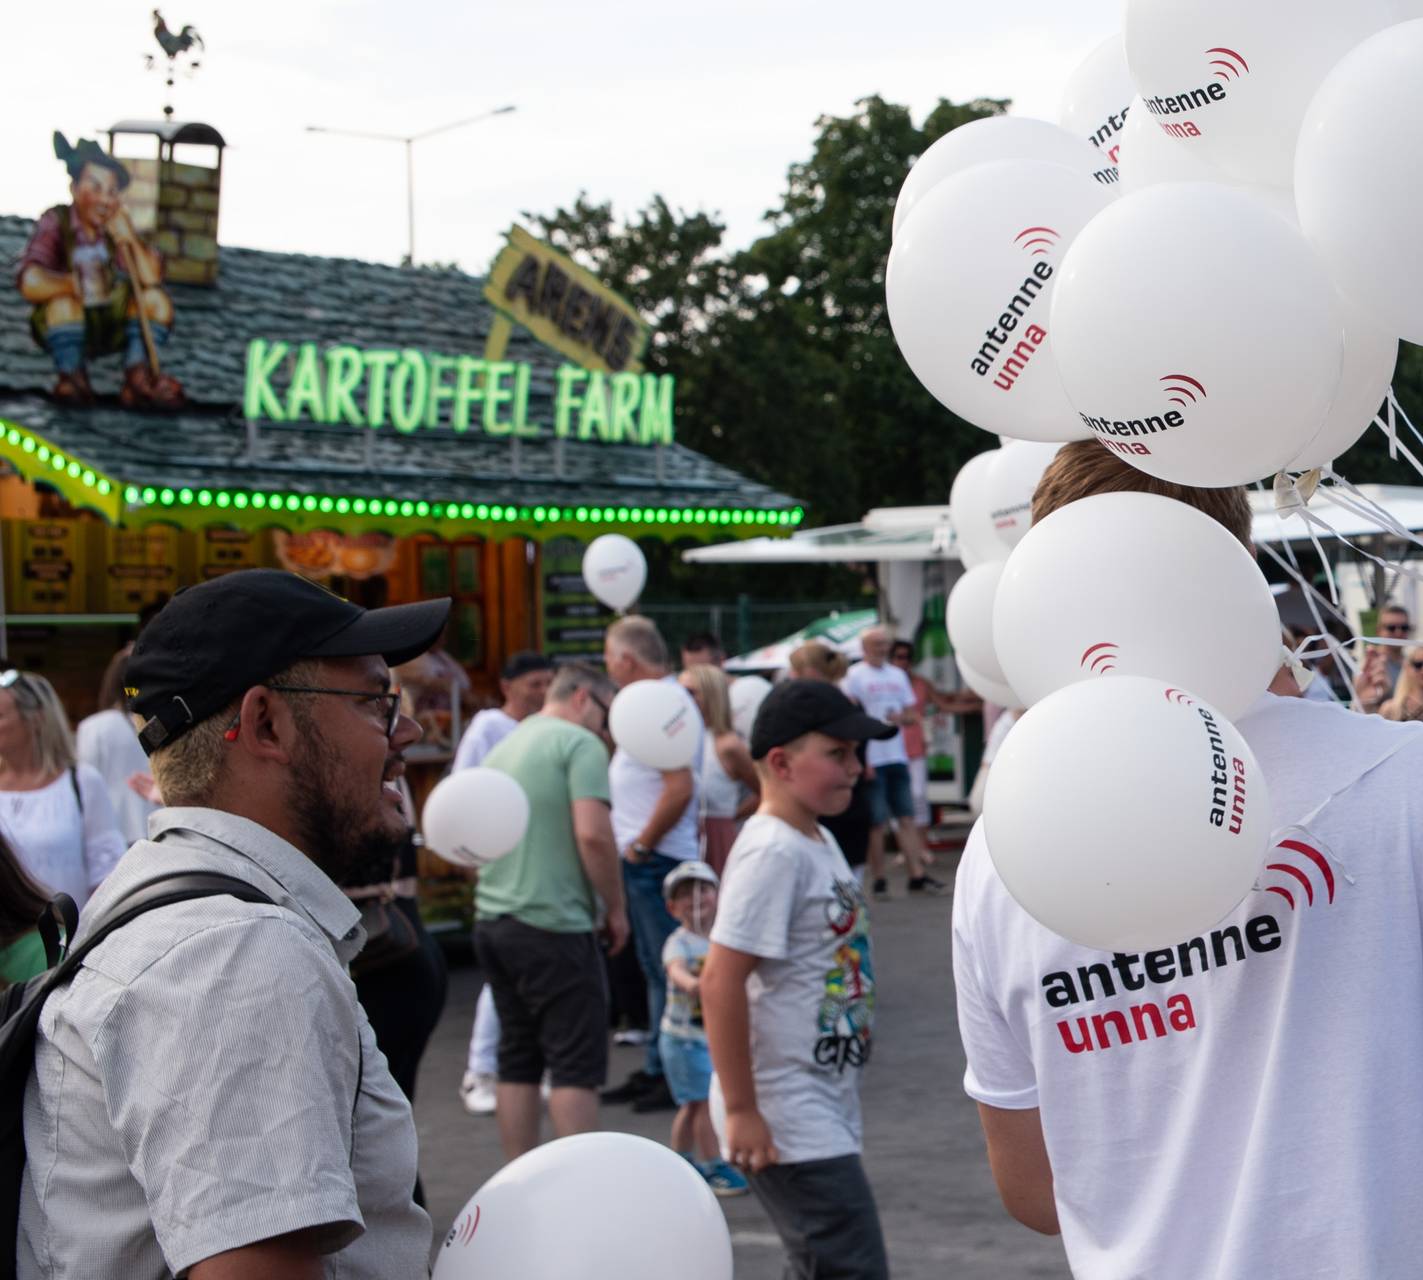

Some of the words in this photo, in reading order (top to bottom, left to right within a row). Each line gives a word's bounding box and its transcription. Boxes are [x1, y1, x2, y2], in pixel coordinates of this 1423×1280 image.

[970, 260, 1054, 377] antenne
[992, 323, 1048, 392] unna
[243, 337, 540, 437] KARTOFFEL
[554, 363, 675, 446] FARM
[1198, 707, 1228, 827] antenne
[1228, 757, 1246, 835] unna
[1041, 914, 1283, 1008] antenne
[1056, 993, 1197, 1054] unna
